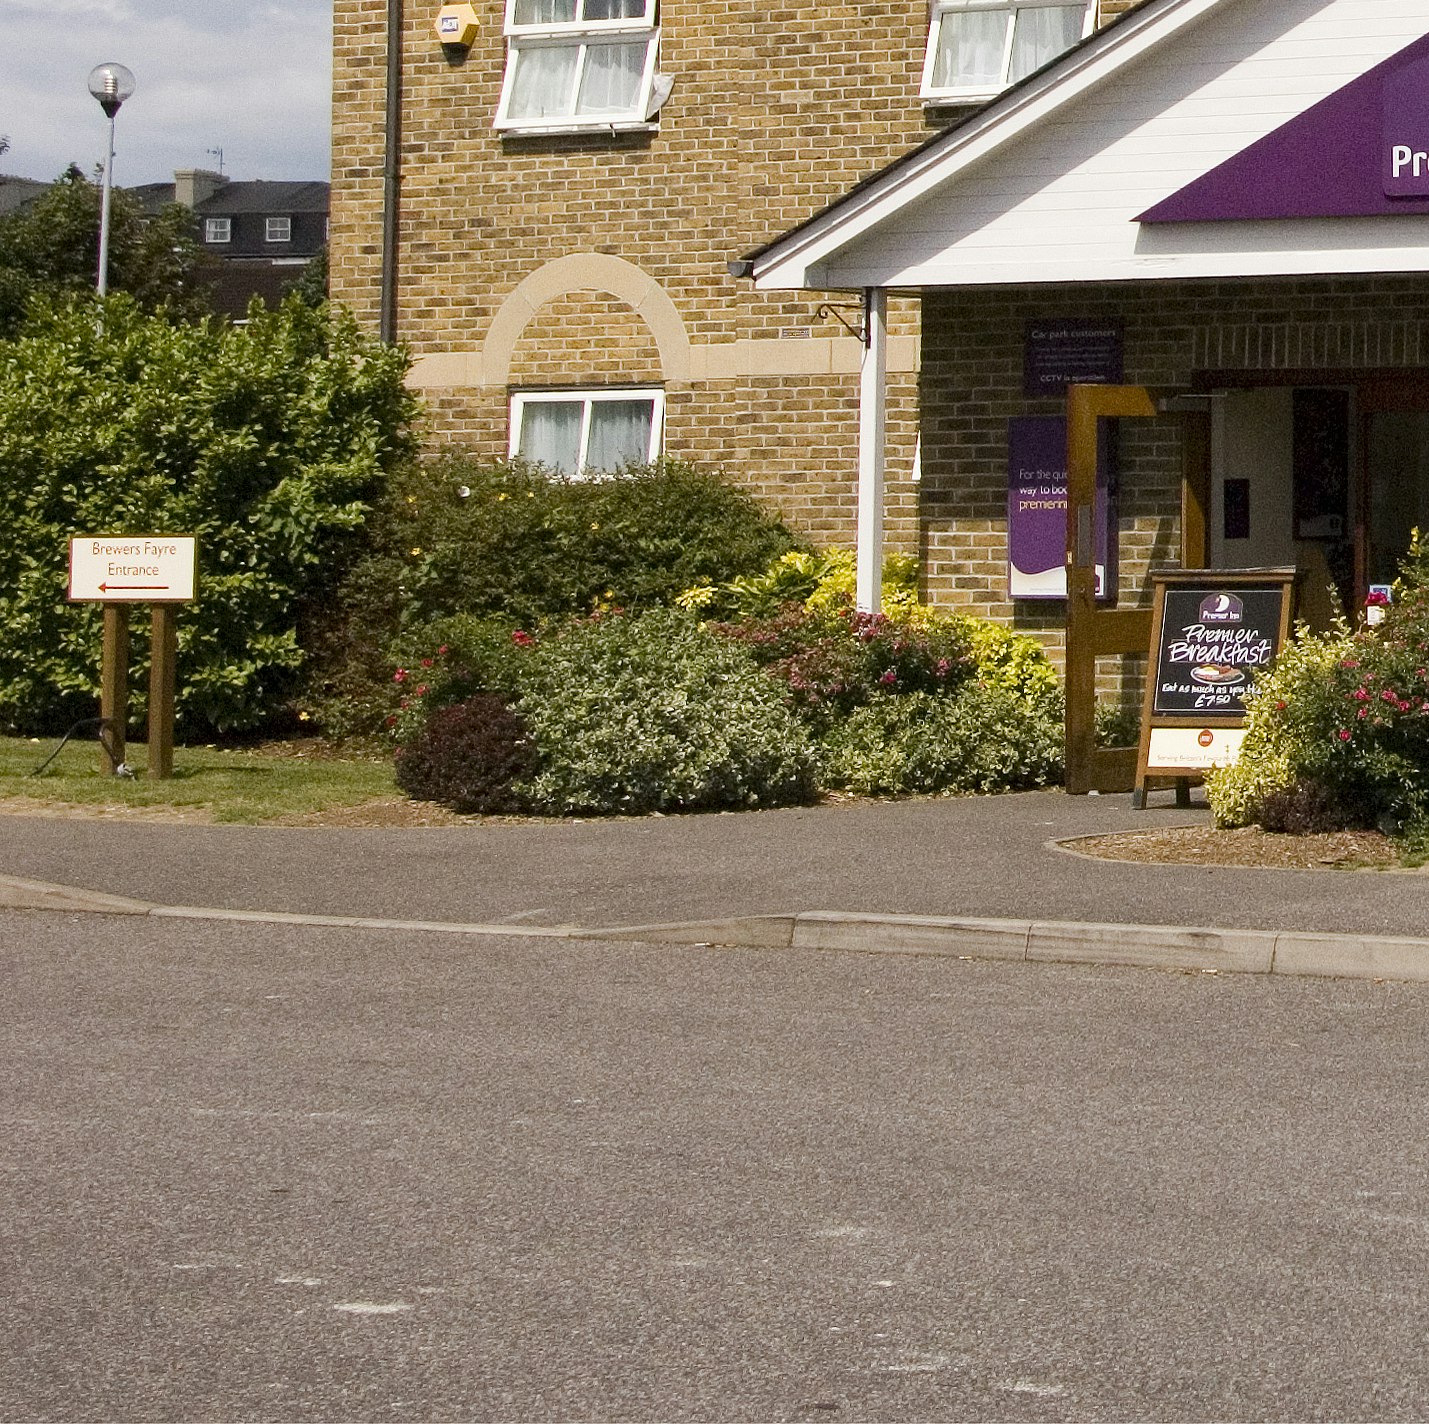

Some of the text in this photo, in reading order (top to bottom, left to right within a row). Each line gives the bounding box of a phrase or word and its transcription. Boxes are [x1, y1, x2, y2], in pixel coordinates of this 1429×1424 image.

[1049, 329, 1069, 340] park
[1071, 330, 1116, 338] customers
[1040, 374, 1062, 382] CCTV
[1019, 468, 1035, 480] For
[1037, 469, 1051, 480] the
[1019, 487, 1038, 498] way
[1040, 484, 1050, 495] to
[92, 541, 177, 558] Brewers Fayre
[108, 562, 160, 576] Entrance
[1202, 610, 1240, 620] Premier Inn
[1181, 624, 1259, 644] Premier
[1168, 639, 1272, 666] Breakfast
[1162, 682, 1177, 692] Eat
[1191, 683, 1215, 694] much
